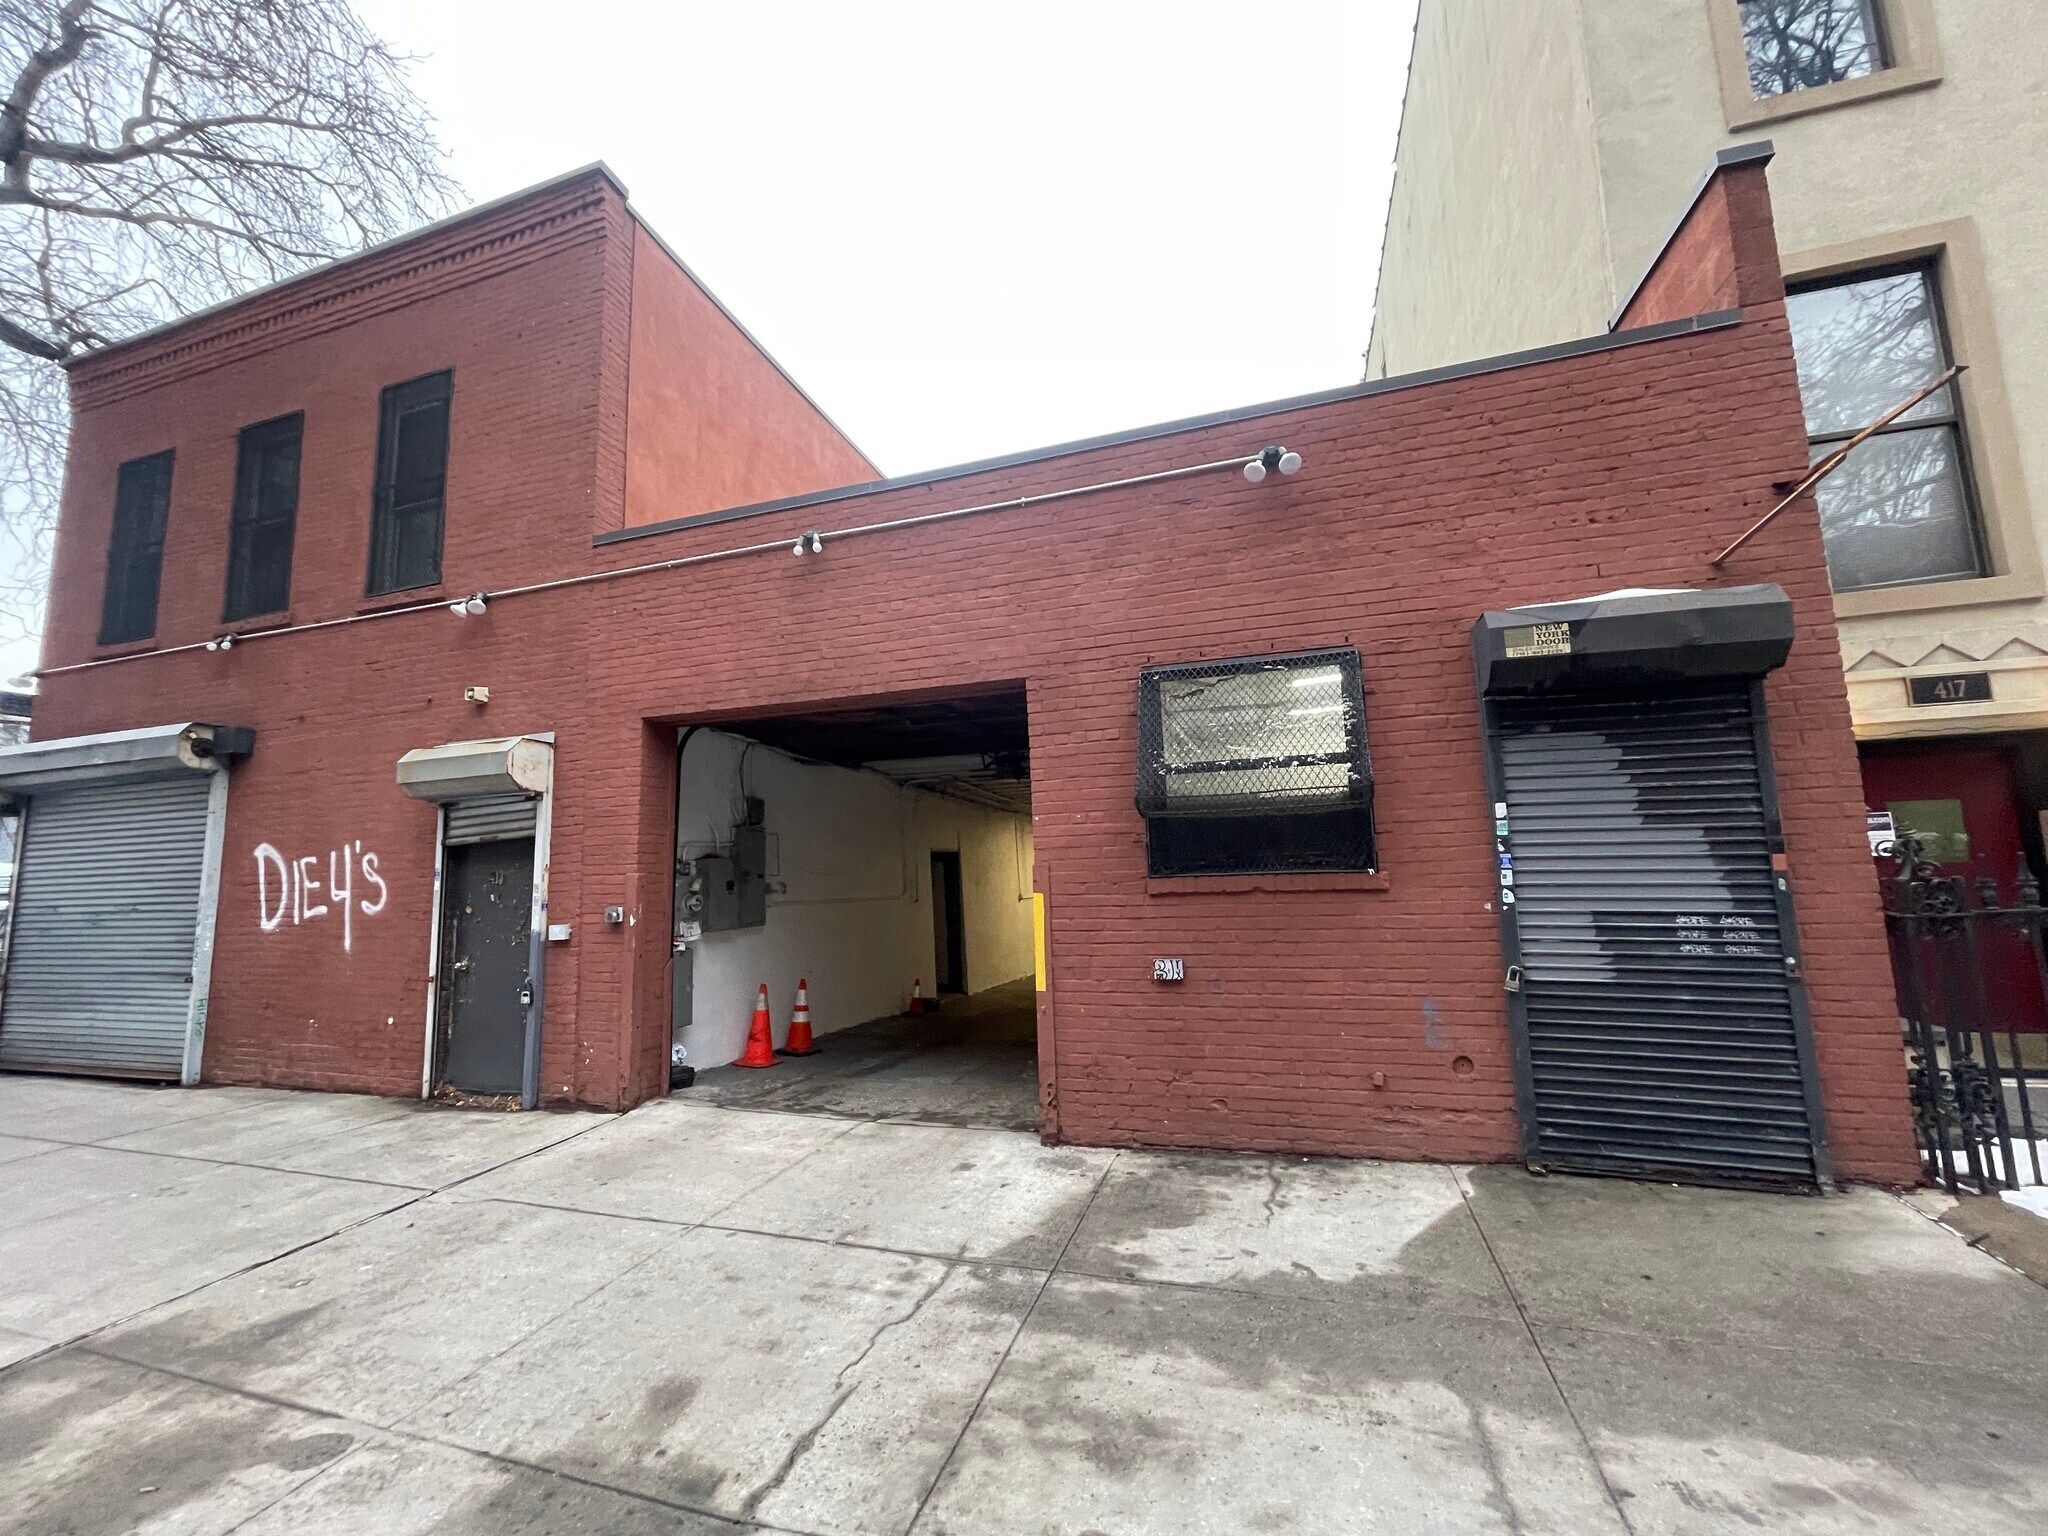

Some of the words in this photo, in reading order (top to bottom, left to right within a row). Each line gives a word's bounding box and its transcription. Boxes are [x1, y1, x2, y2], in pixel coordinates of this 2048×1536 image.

[1535, 623, 1563, 632] NEW
[1536, 630, 1569, 639] YORK
[1536, 637, 1570, 646] DOOR
[1933, 679, 1965, 699] 417
